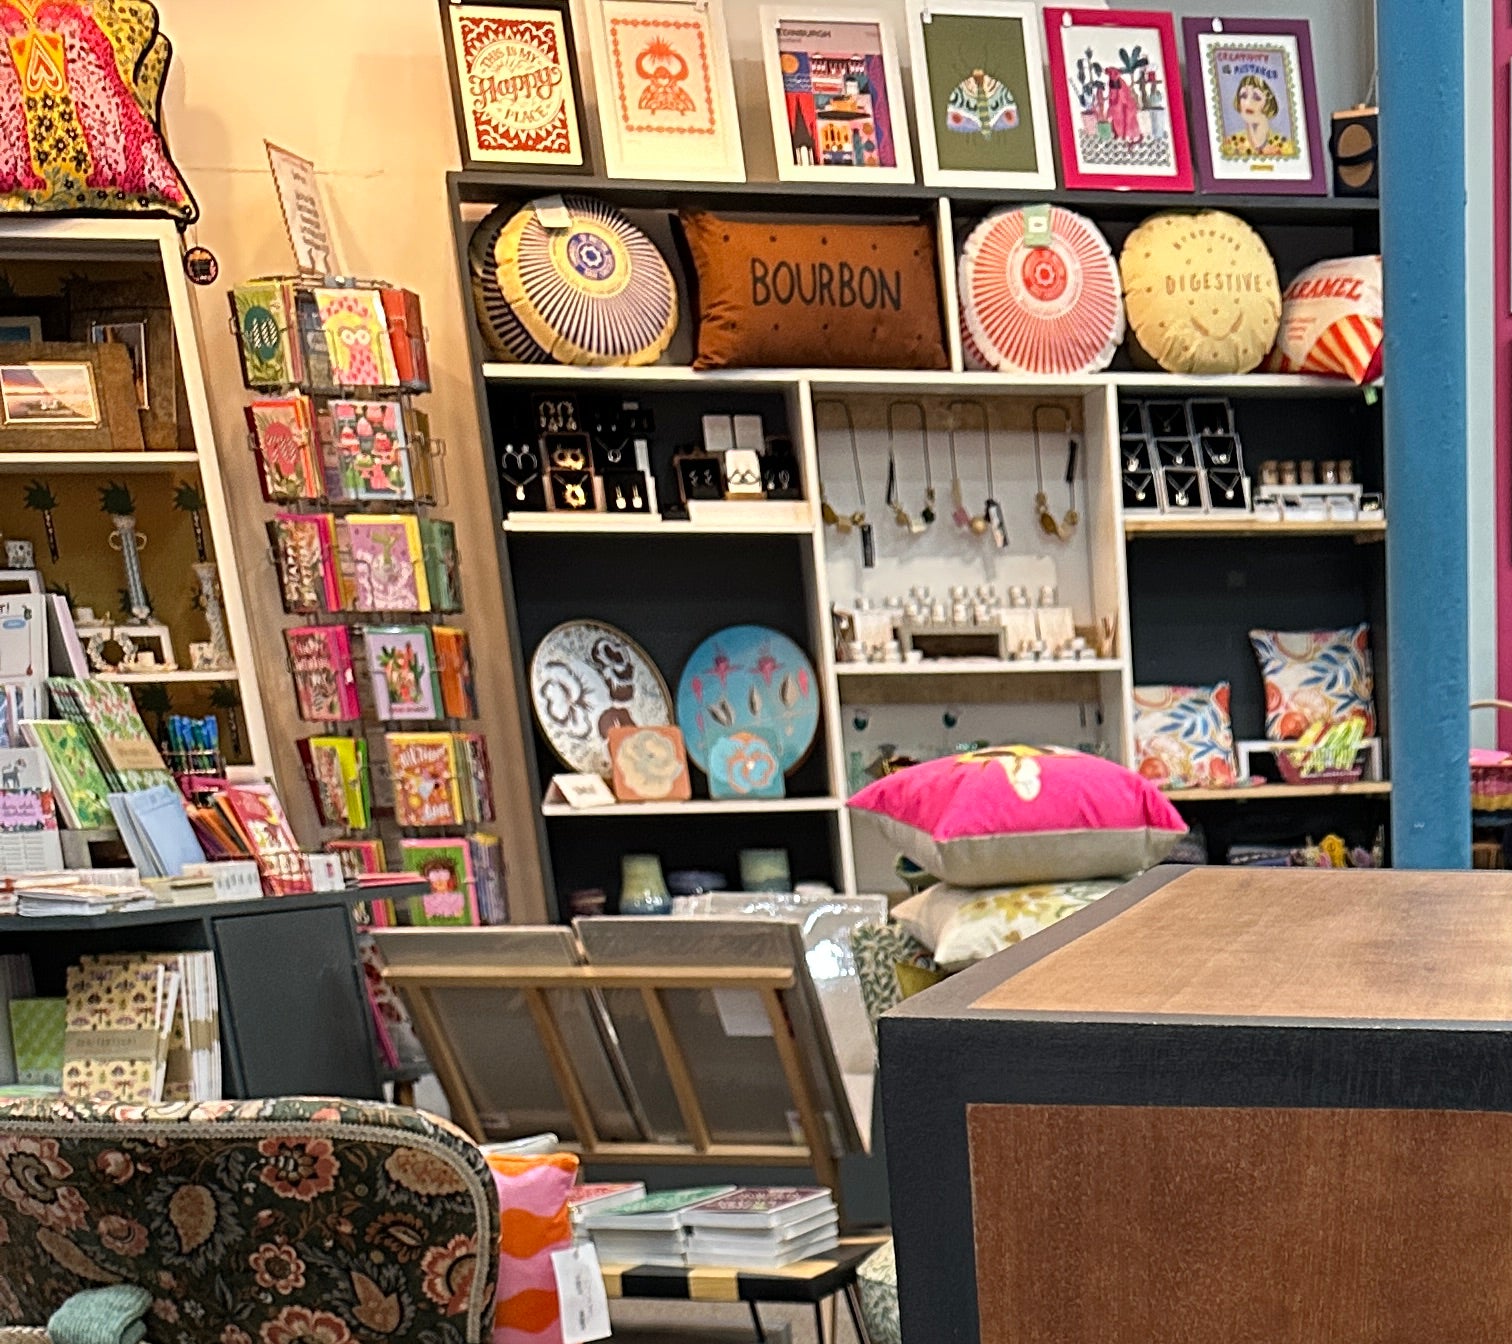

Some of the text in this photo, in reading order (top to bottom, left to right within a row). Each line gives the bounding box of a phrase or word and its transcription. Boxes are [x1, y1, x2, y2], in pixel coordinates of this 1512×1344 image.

[480, 46, 537, 69] THIS IS MY
[468, 64, 563, 110] Happy
[503, 106, 549, 124] PLACE
[749, 255, 902, 311] BOURBON
[1165, 271, 1264, 296] DIGESTIVE
